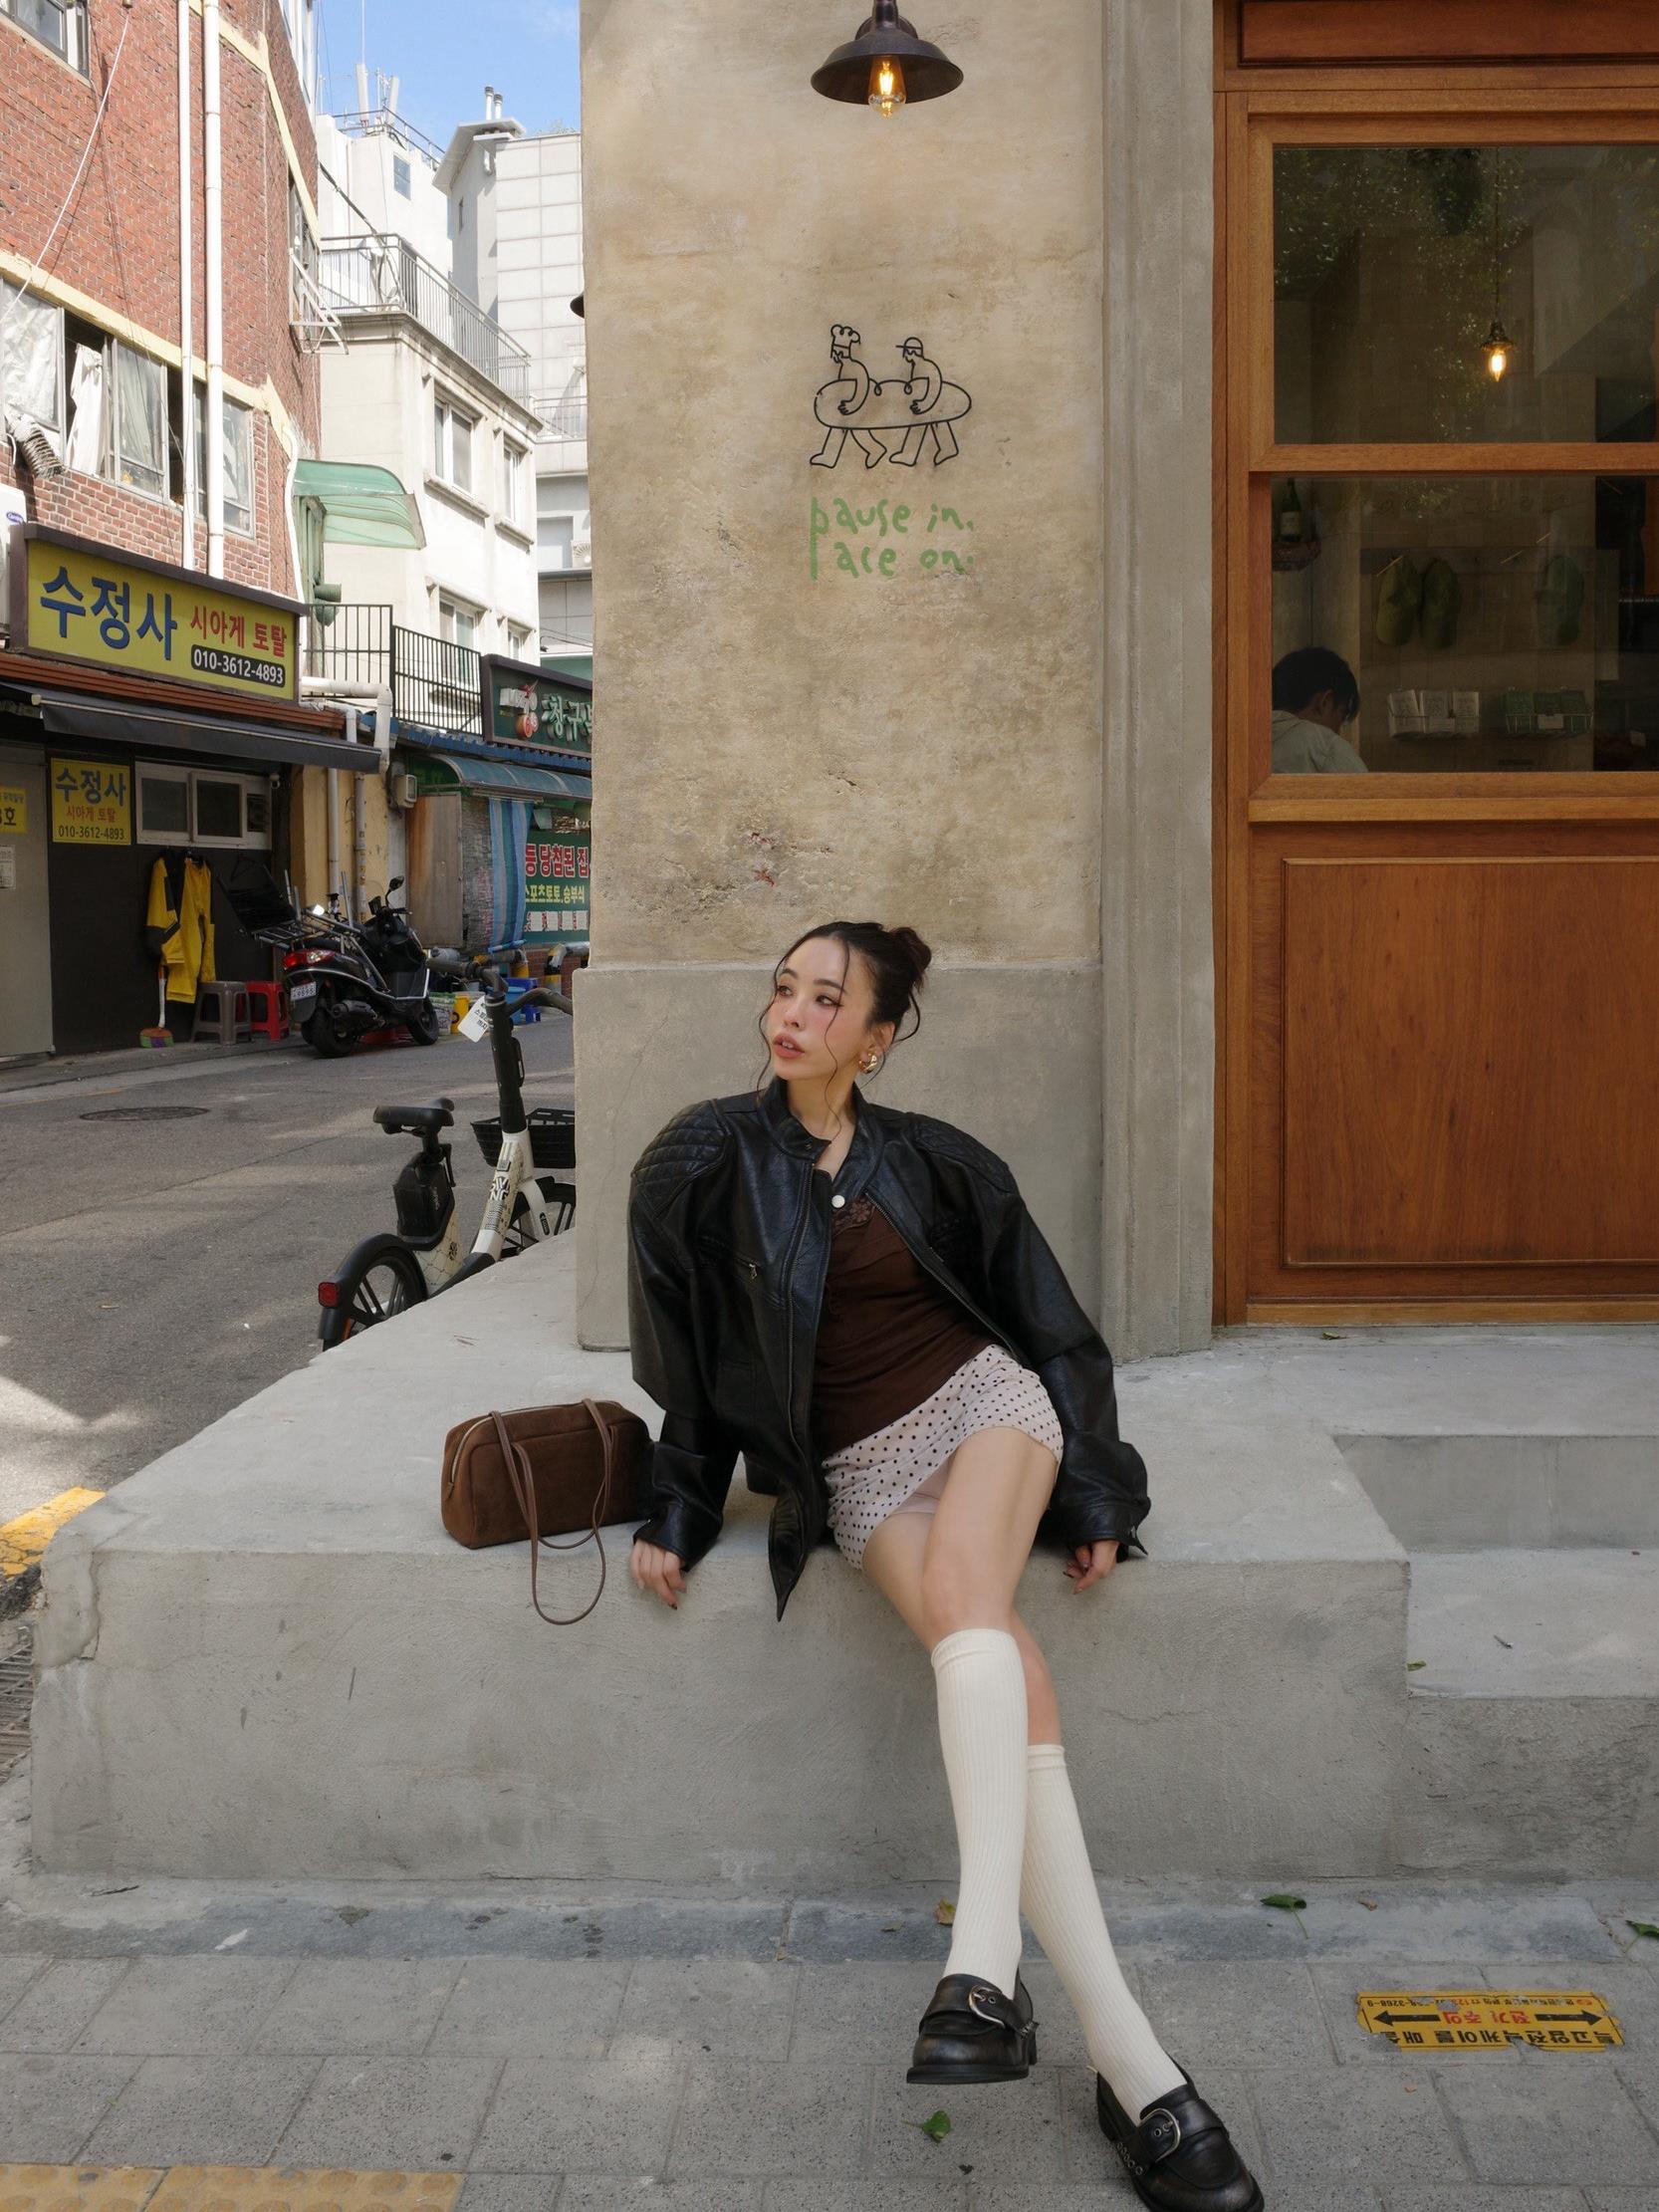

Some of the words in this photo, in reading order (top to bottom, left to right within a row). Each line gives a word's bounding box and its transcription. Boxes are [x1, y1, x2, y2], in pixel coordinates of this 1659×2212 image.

[919, 548, 975, 576] on.
[40, 566, 177, 661] 수정사
[190, 605, 245, 649] 시아게
[252, 621, 288, 658] 토탈
[193, 648, 284, 685] 010-3612-4893
[55, 767, 126, 807] 수정사
[67, 806, 96, 822] 시아게
[58, 825, 124, 841] 010-3612-4893
[539, 844, 576, 878] 당첨된
[578, 847, 590, 878] 집
[1442, 2011, 1483, 2025] 주의
[1490, 2011, 1532, 2025] 전기
